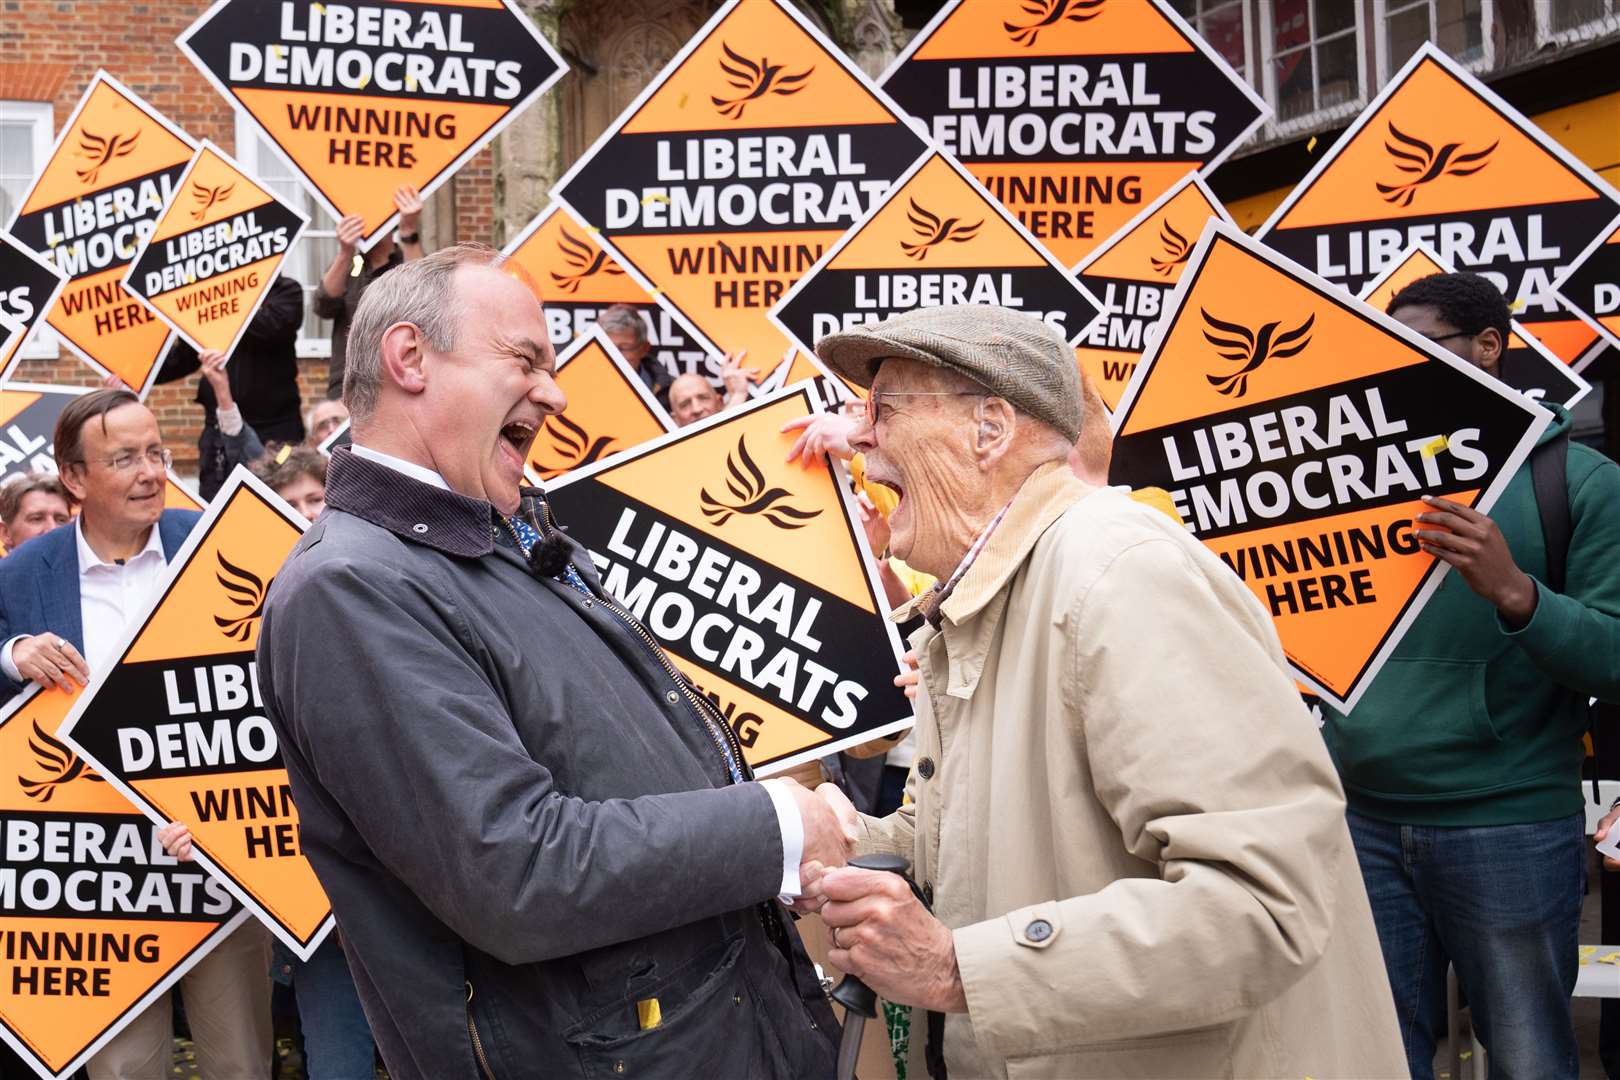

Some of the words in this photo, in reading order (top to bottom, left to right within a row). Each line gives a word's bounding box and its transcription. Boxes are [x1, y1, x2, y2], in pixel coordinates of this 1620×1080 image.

[281, 2, 474, 52] LIBERAL
[229, 42, 522, 99] DEMOCRATS
[948, 61, 1161, 108] LIBERAL
[287, 104, 456, 140] WINNING
[910, 110, 1217, 156] EMOCRATS
[329, 138, 416, 169] HERE
[657, 134, 866, 181] LIBERAL
[44, 173, 172, 246] LIBERAL
[605, 180, 891, 229] DEMOCRAT
[166, 211, 262, 264] LIBERAL
[145, 226, 288, 297] DEMOCRATS
[175, 272, 259, 312] WINNING
[197, 298, 240, 326] HERE
[855, 273, 1023, 308] LIBERAL
[1162, 387, 1407, 482] LIBERAL
[607, 507, 823, 653] LIBERAL
[1265, 569, 1376, 617] HERE
[0, 819, 178, 866] BERAL
[245, 824, 303, 858] HE
[0, 931, 160, 963] INNING
[12, 966, 111, 997] HERE
